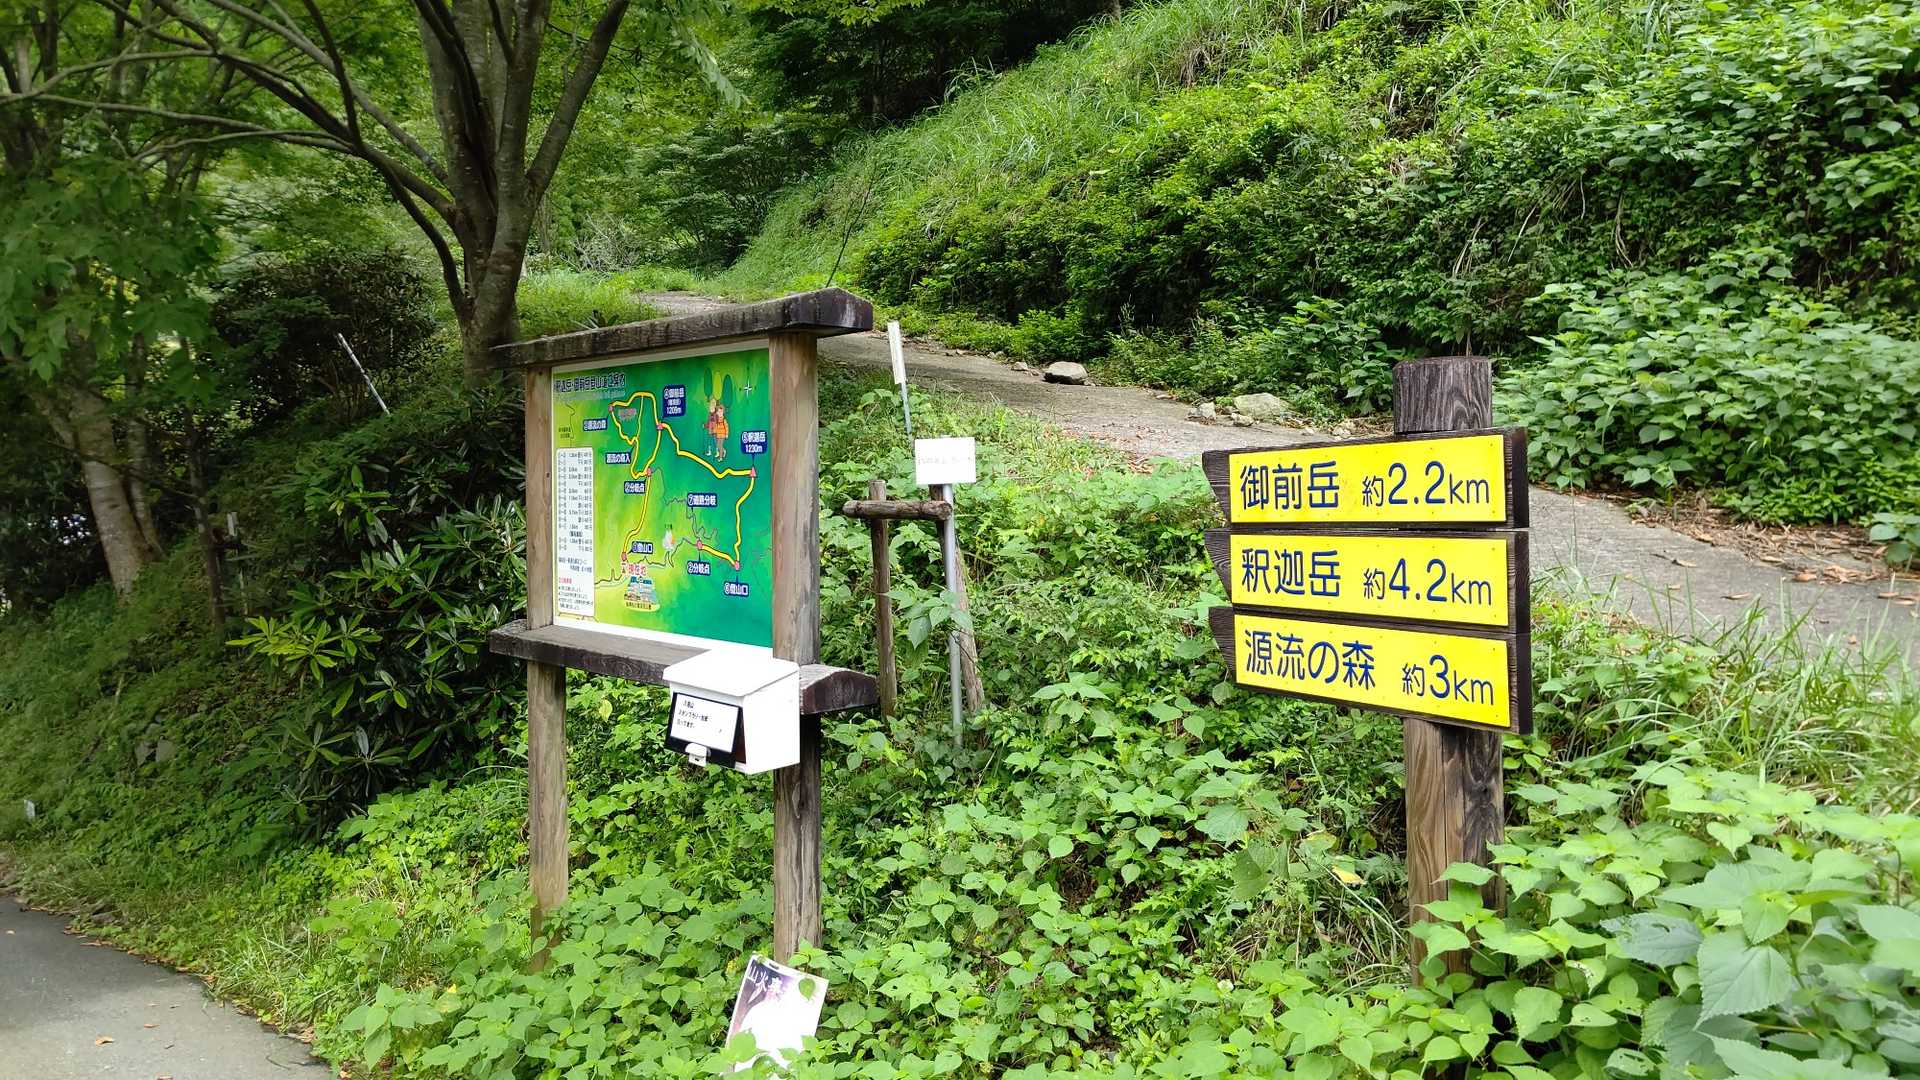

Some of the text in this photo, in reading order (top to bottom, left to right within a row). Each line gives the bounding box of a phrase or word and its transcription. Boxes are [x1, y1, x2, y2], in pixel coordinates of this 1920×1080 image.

[745, 444, 763, 453] 1230m
[1240, 460, 1490, 510] 御前岳 約2.2km
[1241, 548, 1492, 606] 釈迦岳 約4.2km
[1244, 629, 1494, 705] 源流の森 約3km
